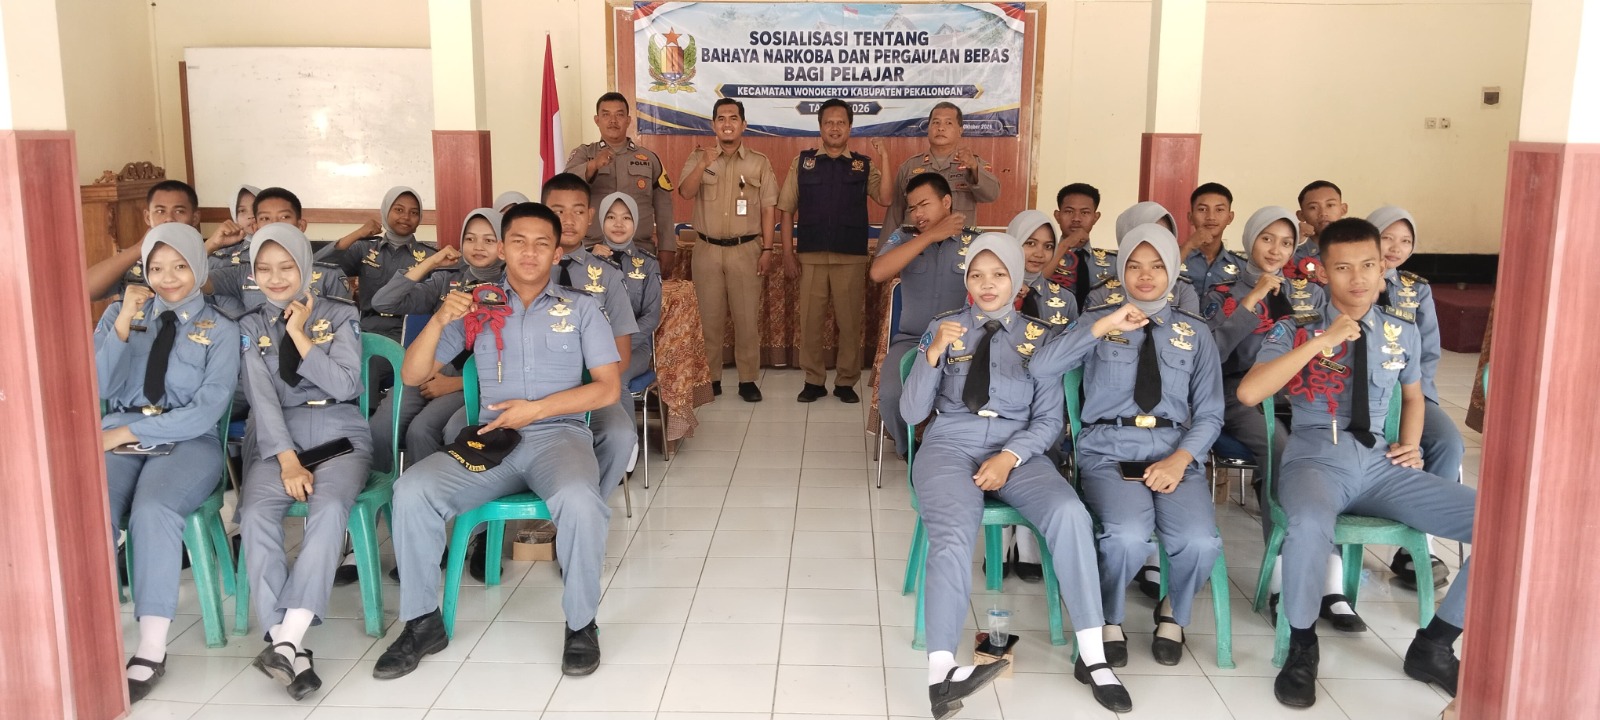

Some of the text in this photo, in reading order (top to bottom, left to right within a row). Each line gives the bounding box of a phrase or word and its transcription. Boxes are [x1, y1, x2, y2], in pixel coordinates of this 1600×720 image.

[749, 30, 929, 46] SOSIALISASI TENTANG
[701, 47, 1010, 64] BAHAYA NARKOBA DAN PERGAULAN BEBAS
[784, 66, 905, 82] BAGI PELAJAR
[737, 86, 963, 97] KECAMATAN WONOKERTO KABUPATEN PEKALONGAN
[850, 103, 870, 113] 026
